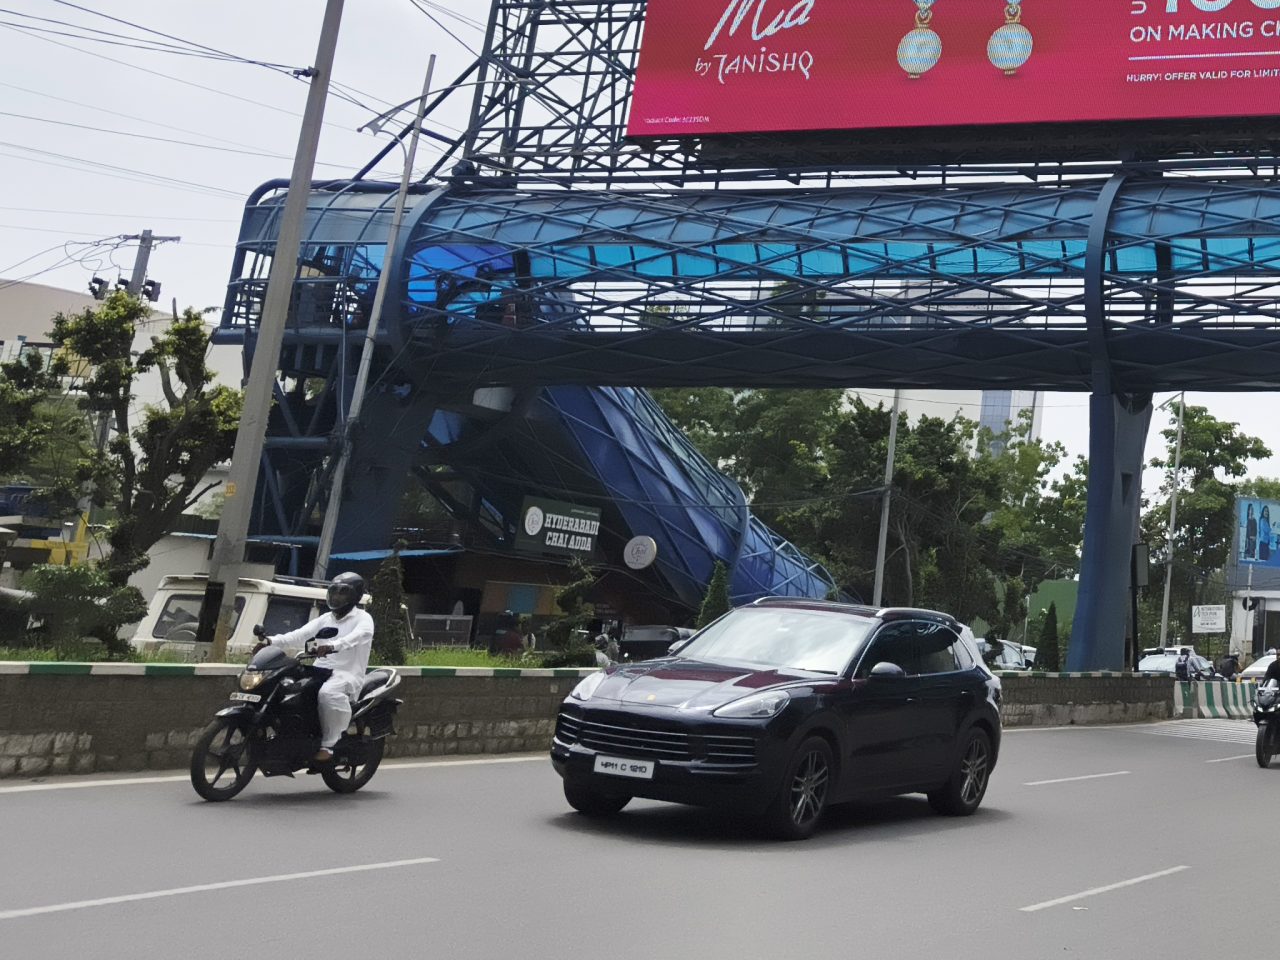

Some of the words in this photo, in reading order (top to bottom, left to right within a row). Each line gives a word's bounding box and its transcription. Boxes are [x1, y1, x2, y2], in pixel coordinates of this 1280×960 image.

[1130, 26, 1161, 43] ON
[1168, 21, 1253, 41] MAKING
[695, 58, 712, 76] by
[1126, 73, 1162, 82] HURRY!
[1164, 71, 1196, 81] OFFER
[1199, 70, 1228, 79] VALID
[1231, 69, 1251, 78] FOR
[544, 513, 600, 536] HYDERABADI
[545, 531, 567, 549] CHAI
[567, 536, 592, 552] ADDA
